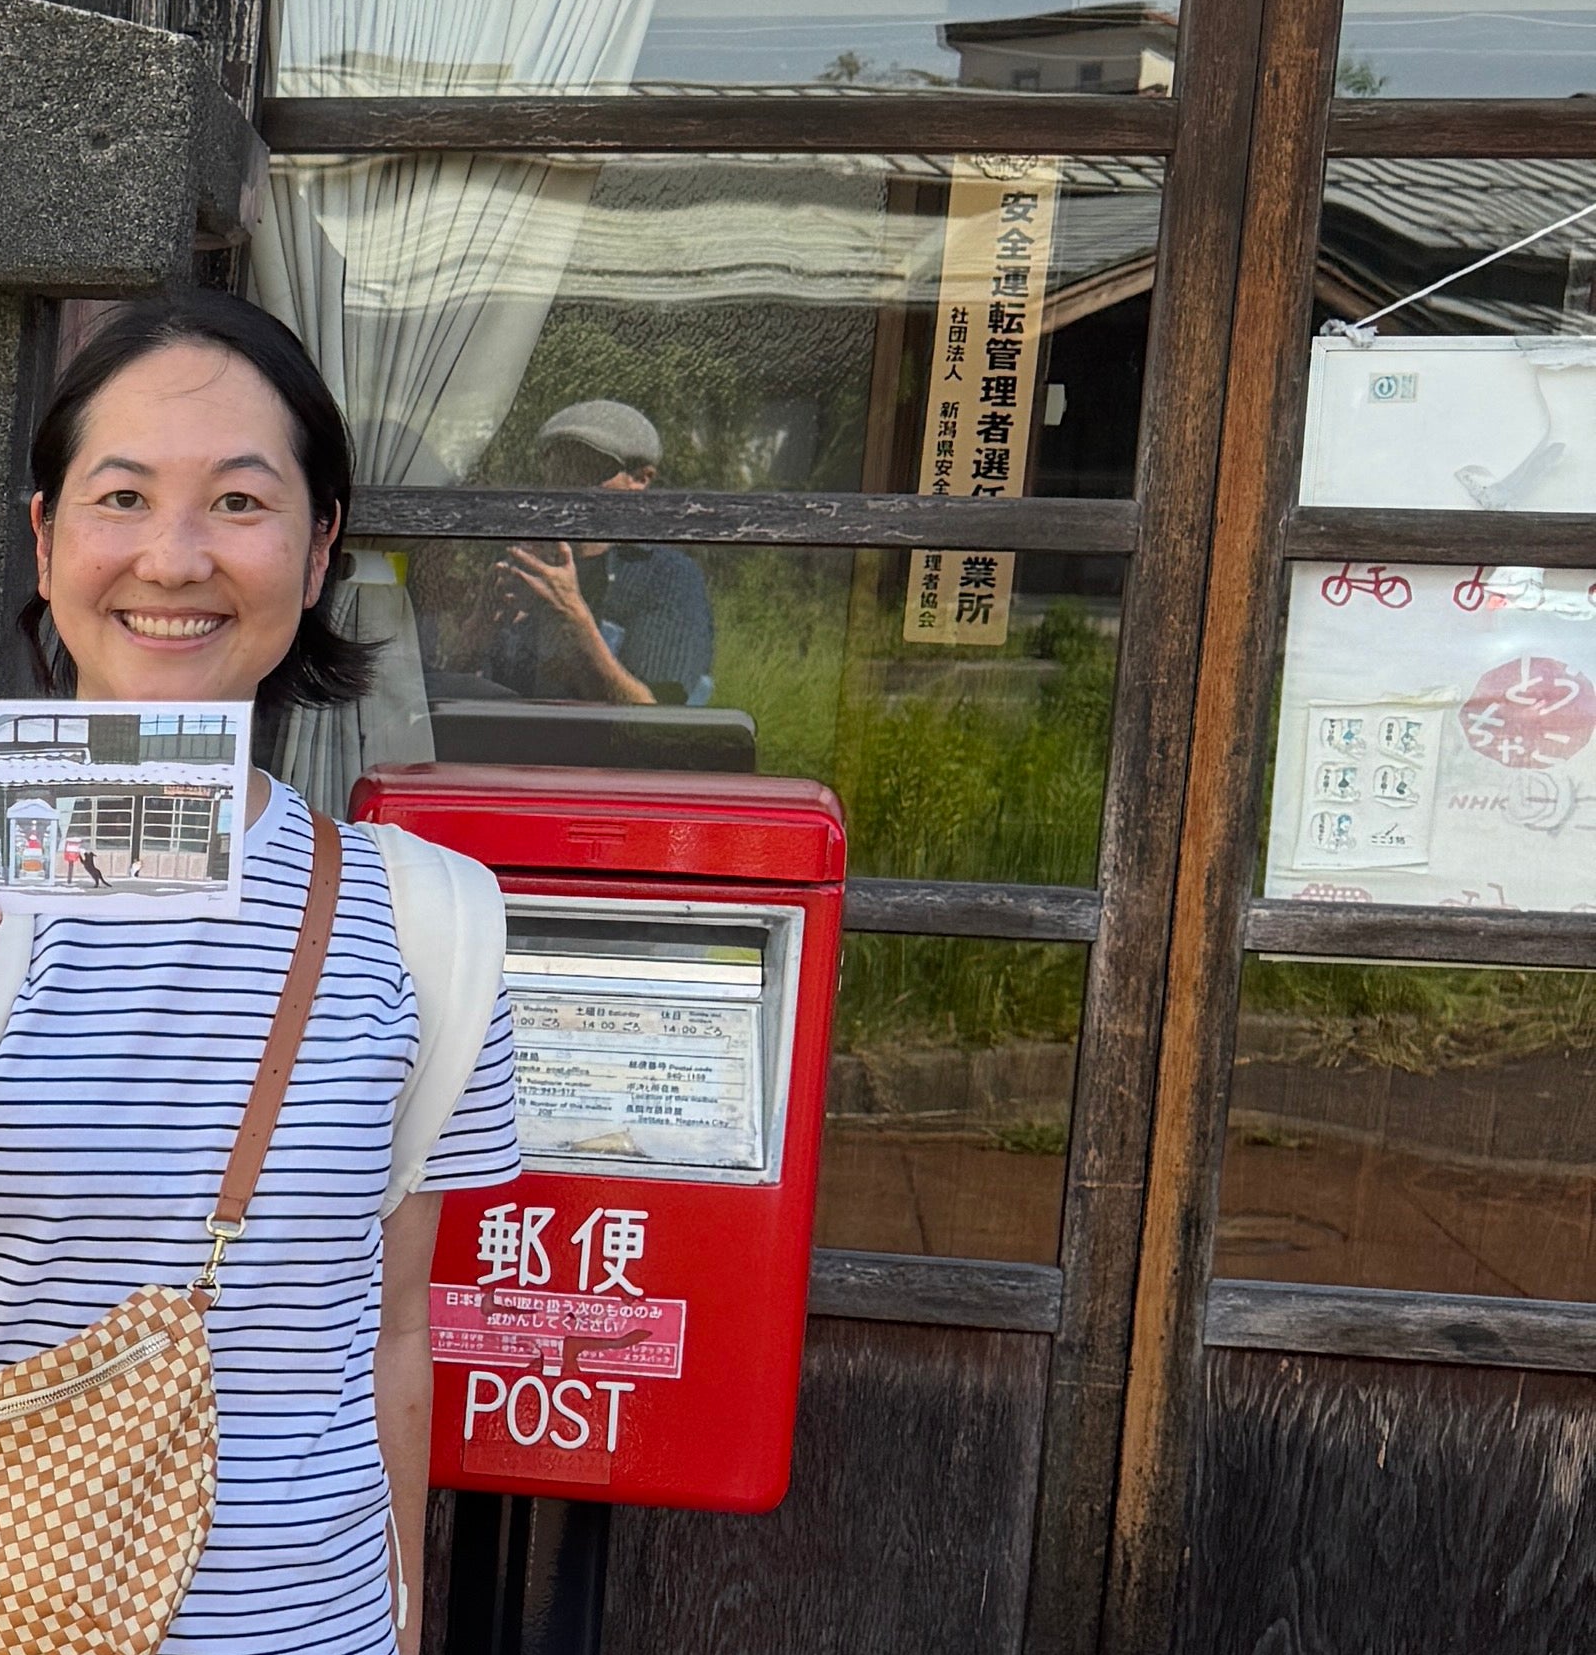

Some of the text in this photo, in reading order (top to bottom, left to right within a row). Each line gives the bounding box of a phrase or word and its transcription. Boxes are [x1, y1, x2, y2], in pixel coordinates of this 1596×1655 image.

[944, 306, 969, 381] 社団法人
[955, 191, 1039, 625] 安全運転管理者選業所
[1467, 702, 1571, 765] ちゃこ
[1448, 794, 1509, 811] NHK
[476, 1202, 650, 1298] 郵便
[463, 1370, 636, 1454] POST
